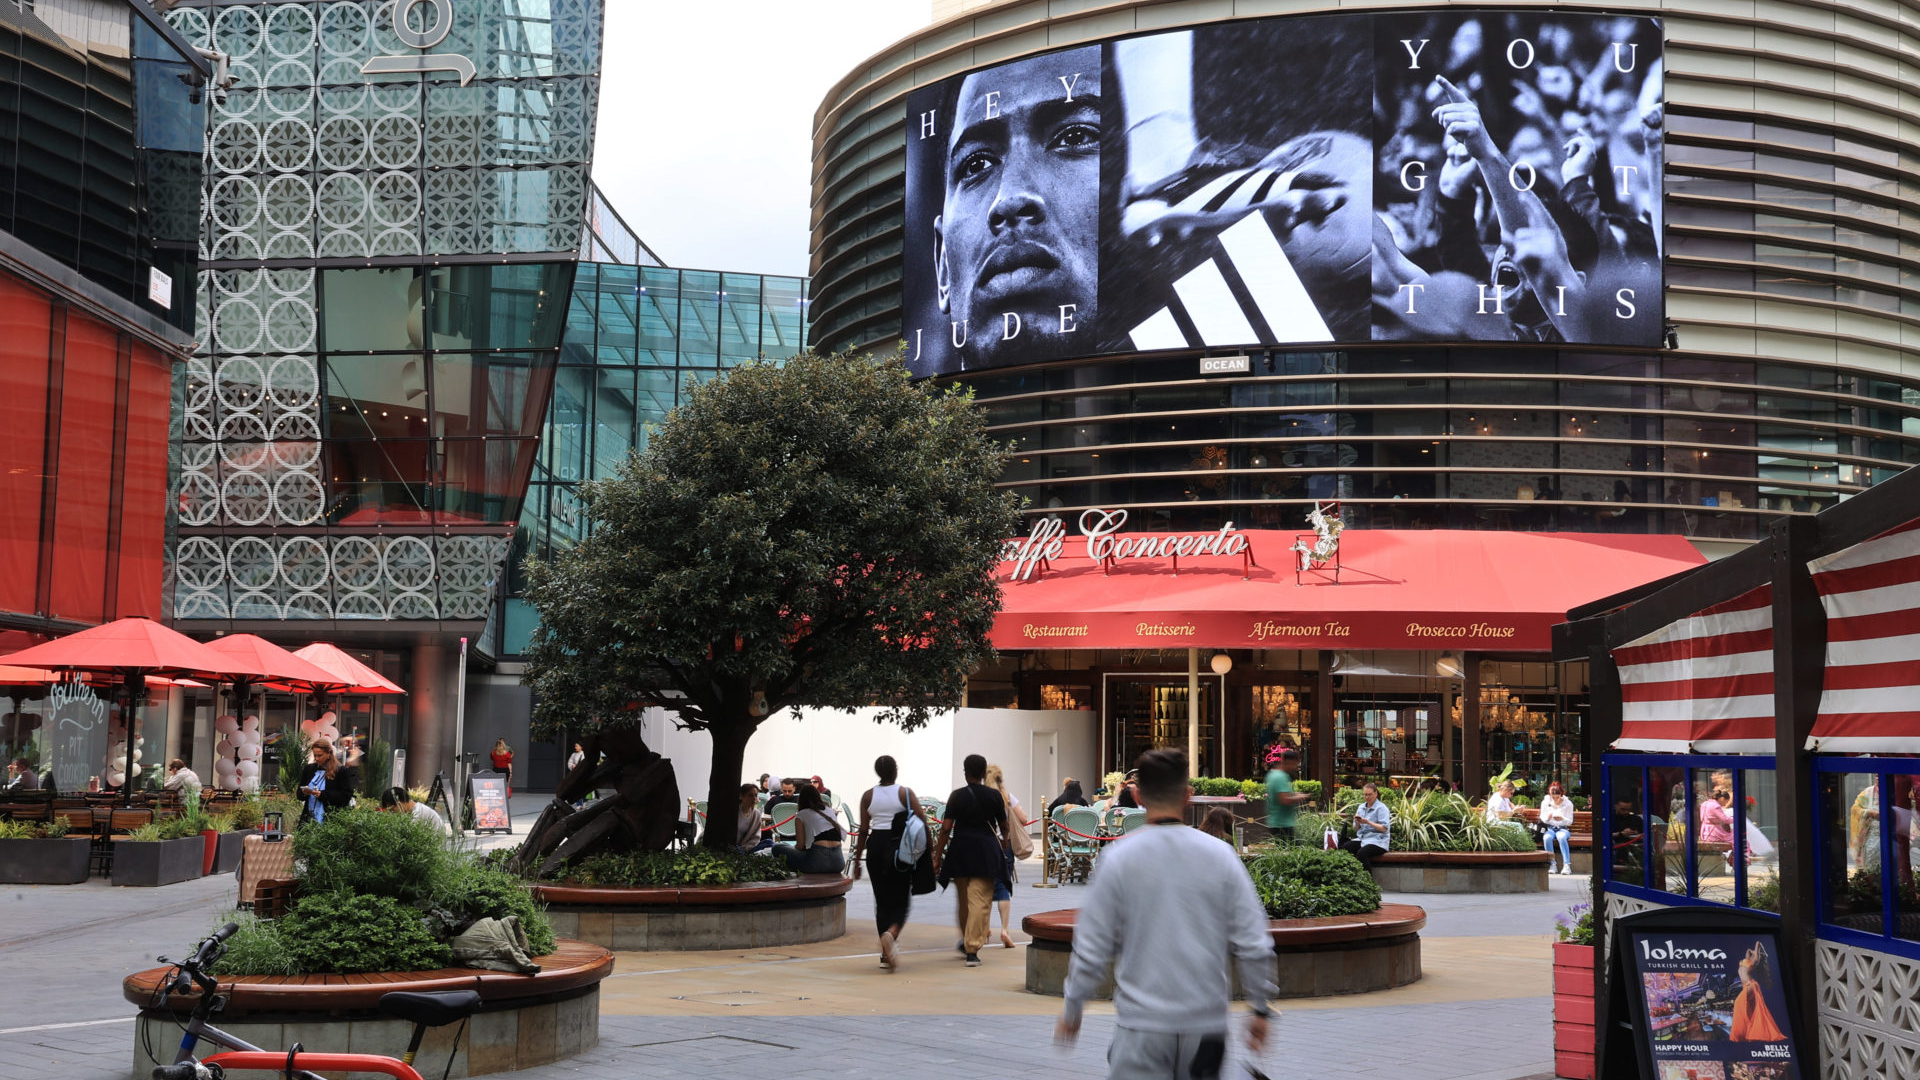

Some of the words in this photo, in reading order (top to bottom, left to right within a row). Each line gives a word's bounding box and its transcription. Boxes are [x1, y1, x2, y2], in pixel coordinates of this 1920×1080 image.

[1400, 37, 1639, 74] YOU
[919, 71, 1082, 141] HEY
[1400, 160, 1639, 196] GOT
[1398, 283, 1637, 319] THIS
[913, 303, 1078, 362] JUDE
[1204, 359, 1245, 370] OCEAN
[1000, 517, 1066, 580] affé
[1078, 508, 1249, 565] Concerto
[1023, 623, 1089, 639] Restaurant
[1135, 622, 1196, 636] Patisserie
[1248, 621, 1321, 640] Afternoon
[1324, 621, 1350, 636] Tea
[1405, 622, 1467, 637] Prosecco
[1469, 622, 1515, 638] House
[48, 672, 104, 724] Southern
[68, 736, 83, 756] PIT
[1640, 940, 1727, 960] lokma
[1654, 1044, 1683, 1052] HAPPY
[1751, 1050, 1792, 1058] DANCING
[1764, 1044, 1790, 1052] BELLY
